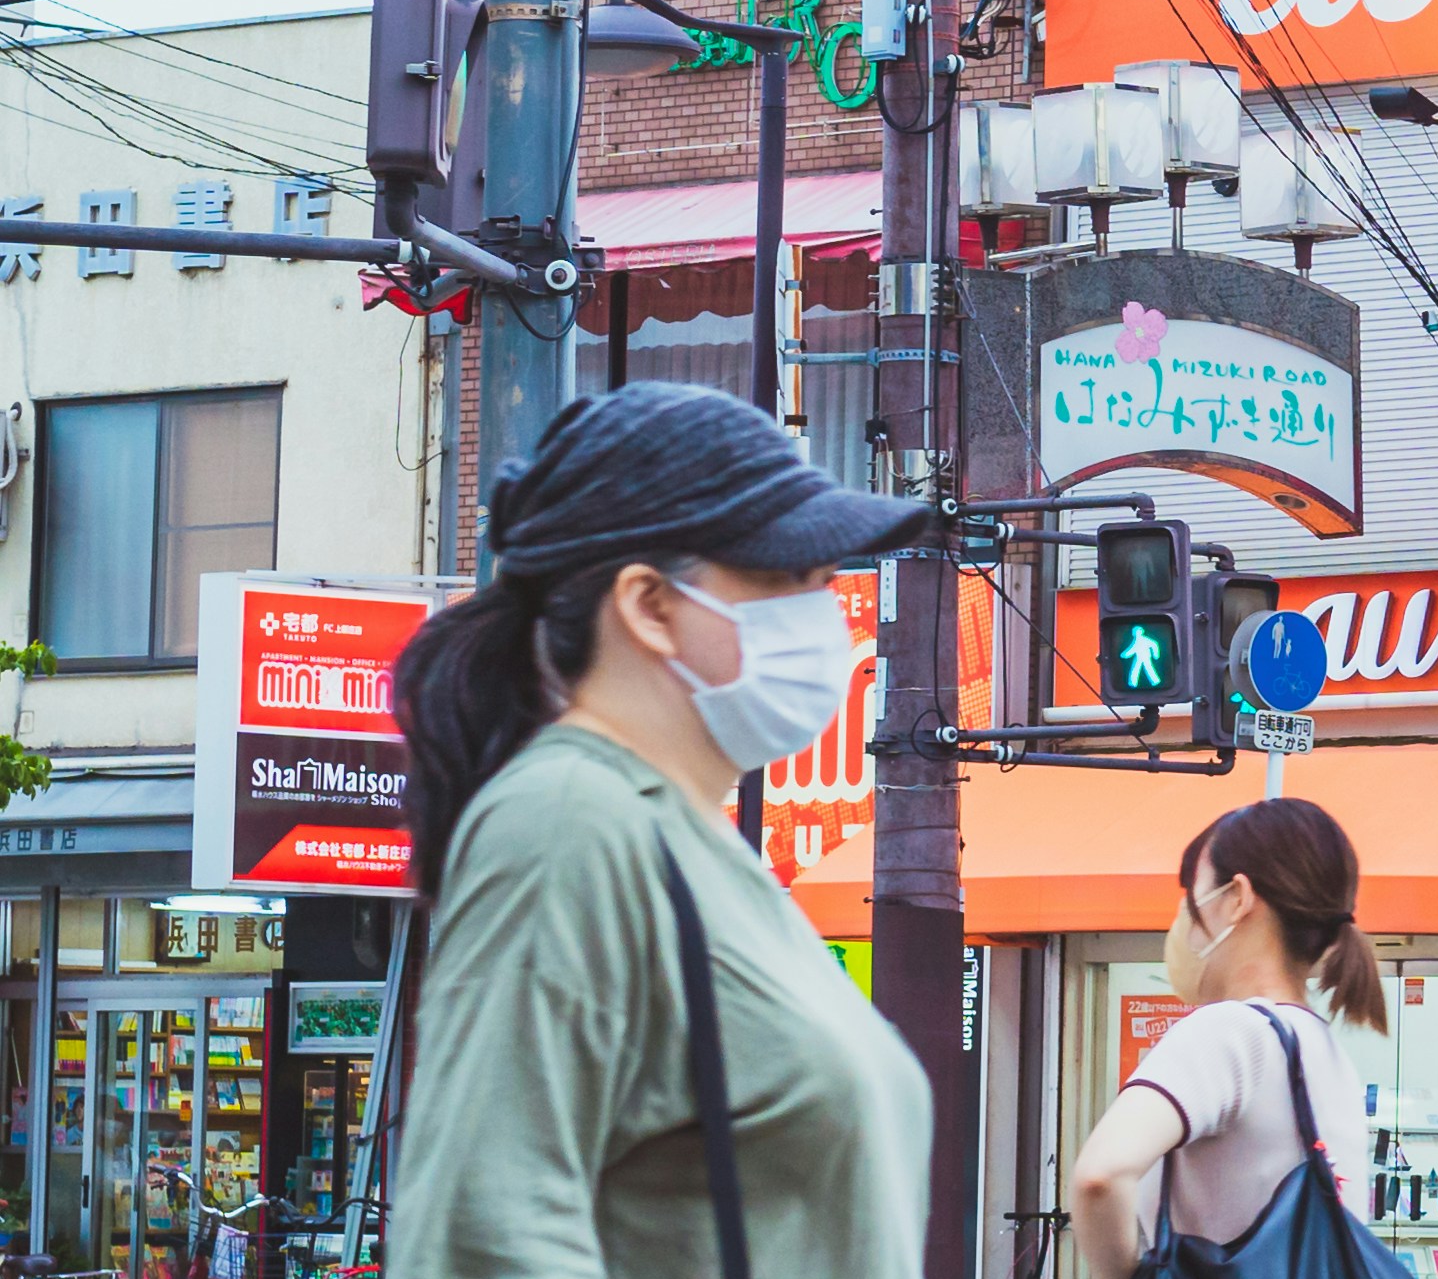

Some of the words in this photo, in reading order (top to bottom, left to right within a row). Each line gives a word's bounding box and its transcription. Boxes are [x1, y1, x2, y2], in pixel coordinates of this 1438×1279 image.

[1054, 349, 1116, 369] HANA
[1055, 358, 1335, 462] はなみずき通り
[282, 612, 319, 634] 宅都
[1259, 714, 1313, 737] 自転車通行可
[1260, 735, 1308, 752] ここから
